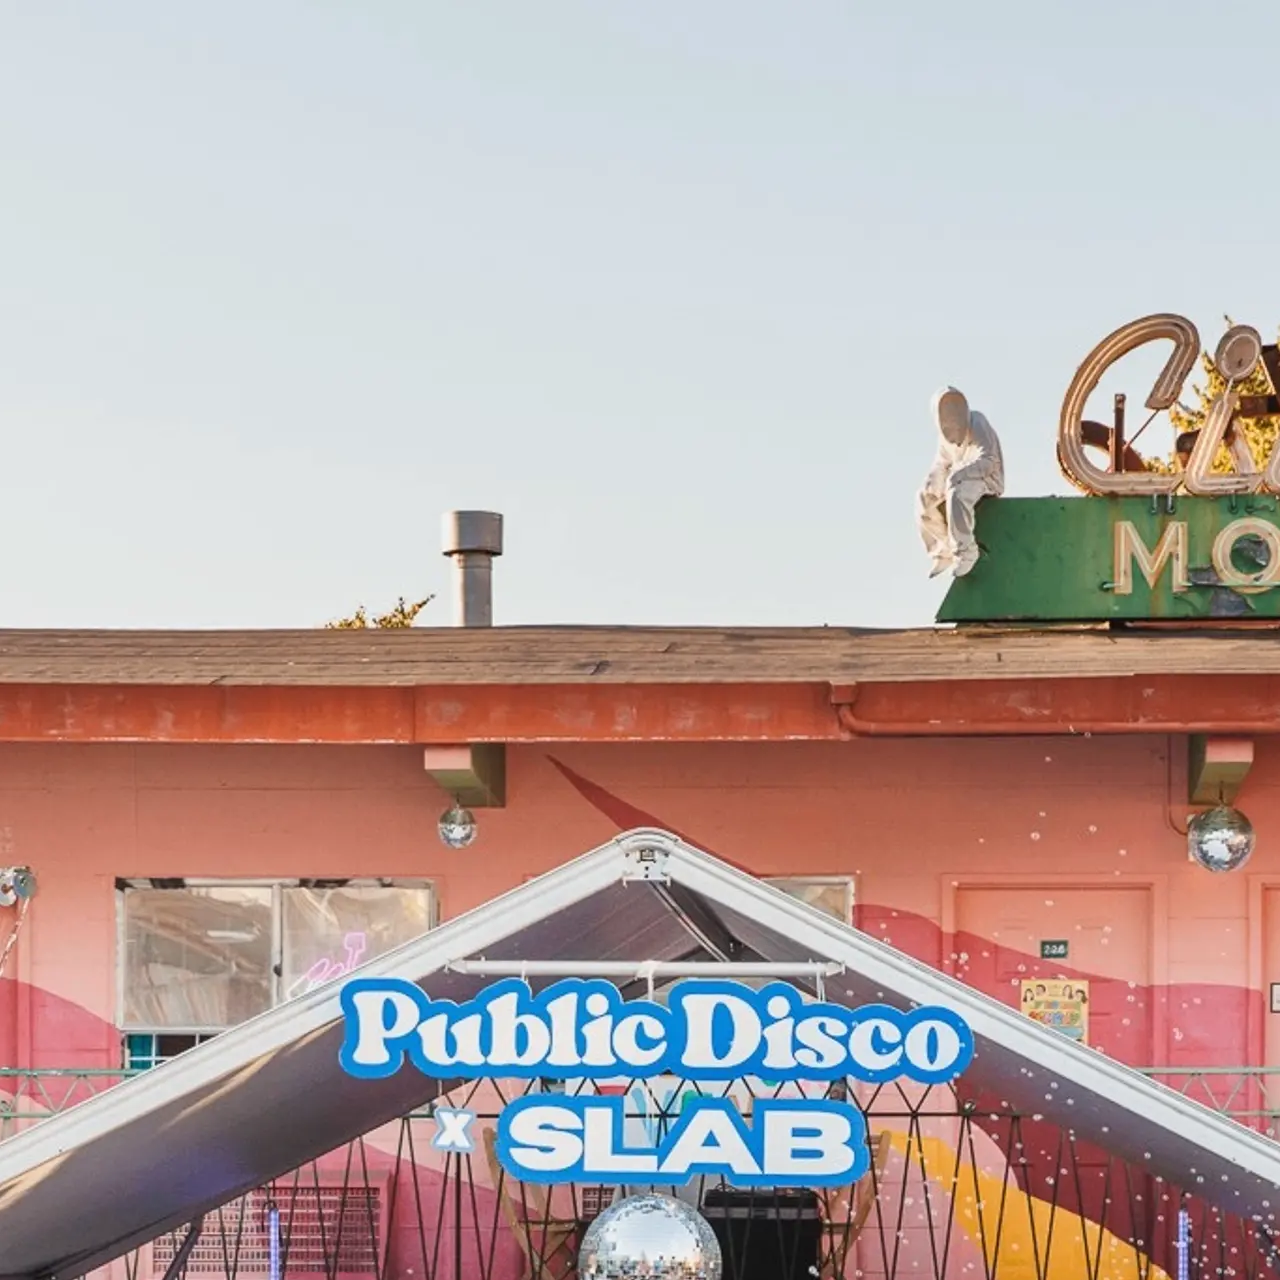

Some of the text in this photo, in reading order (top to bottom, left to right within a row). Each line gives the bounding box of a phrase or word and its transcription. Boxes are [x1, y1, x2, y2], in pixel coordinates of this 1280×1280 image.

[350, 990, 961, 1072] Public Disco
[508, 1106, 856, 1176] SLAB
